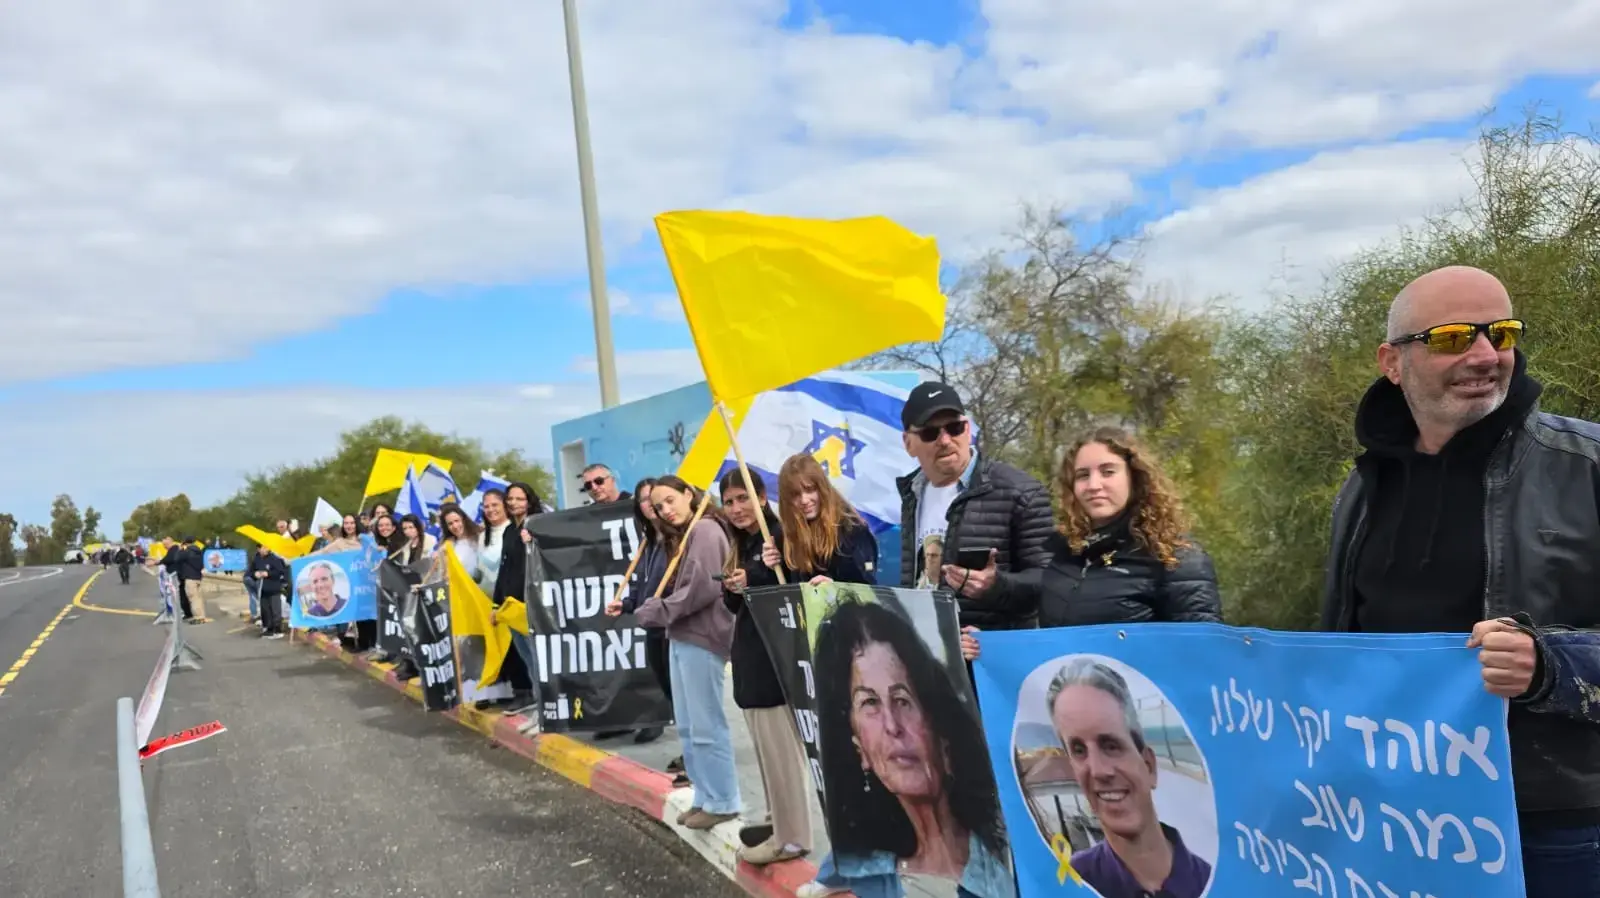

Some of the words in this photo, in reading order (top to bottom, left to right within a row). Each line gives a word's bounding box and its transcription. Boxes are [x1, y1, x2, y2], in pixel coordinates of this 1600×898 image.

[541, 573, 637, 628] חטוף
[535, 627, 647, 683] האחרון
[1211, 677, 1273, 741] שלנו,
[1282, 701, 1331, 768] יקר
[1345, 715, 1499, 781] אוהד
[1294, 779, 1365, 842] טוב
[1380, 803, 1506, 874] כמה
[1234, 820, 1337, 898] הביתה
